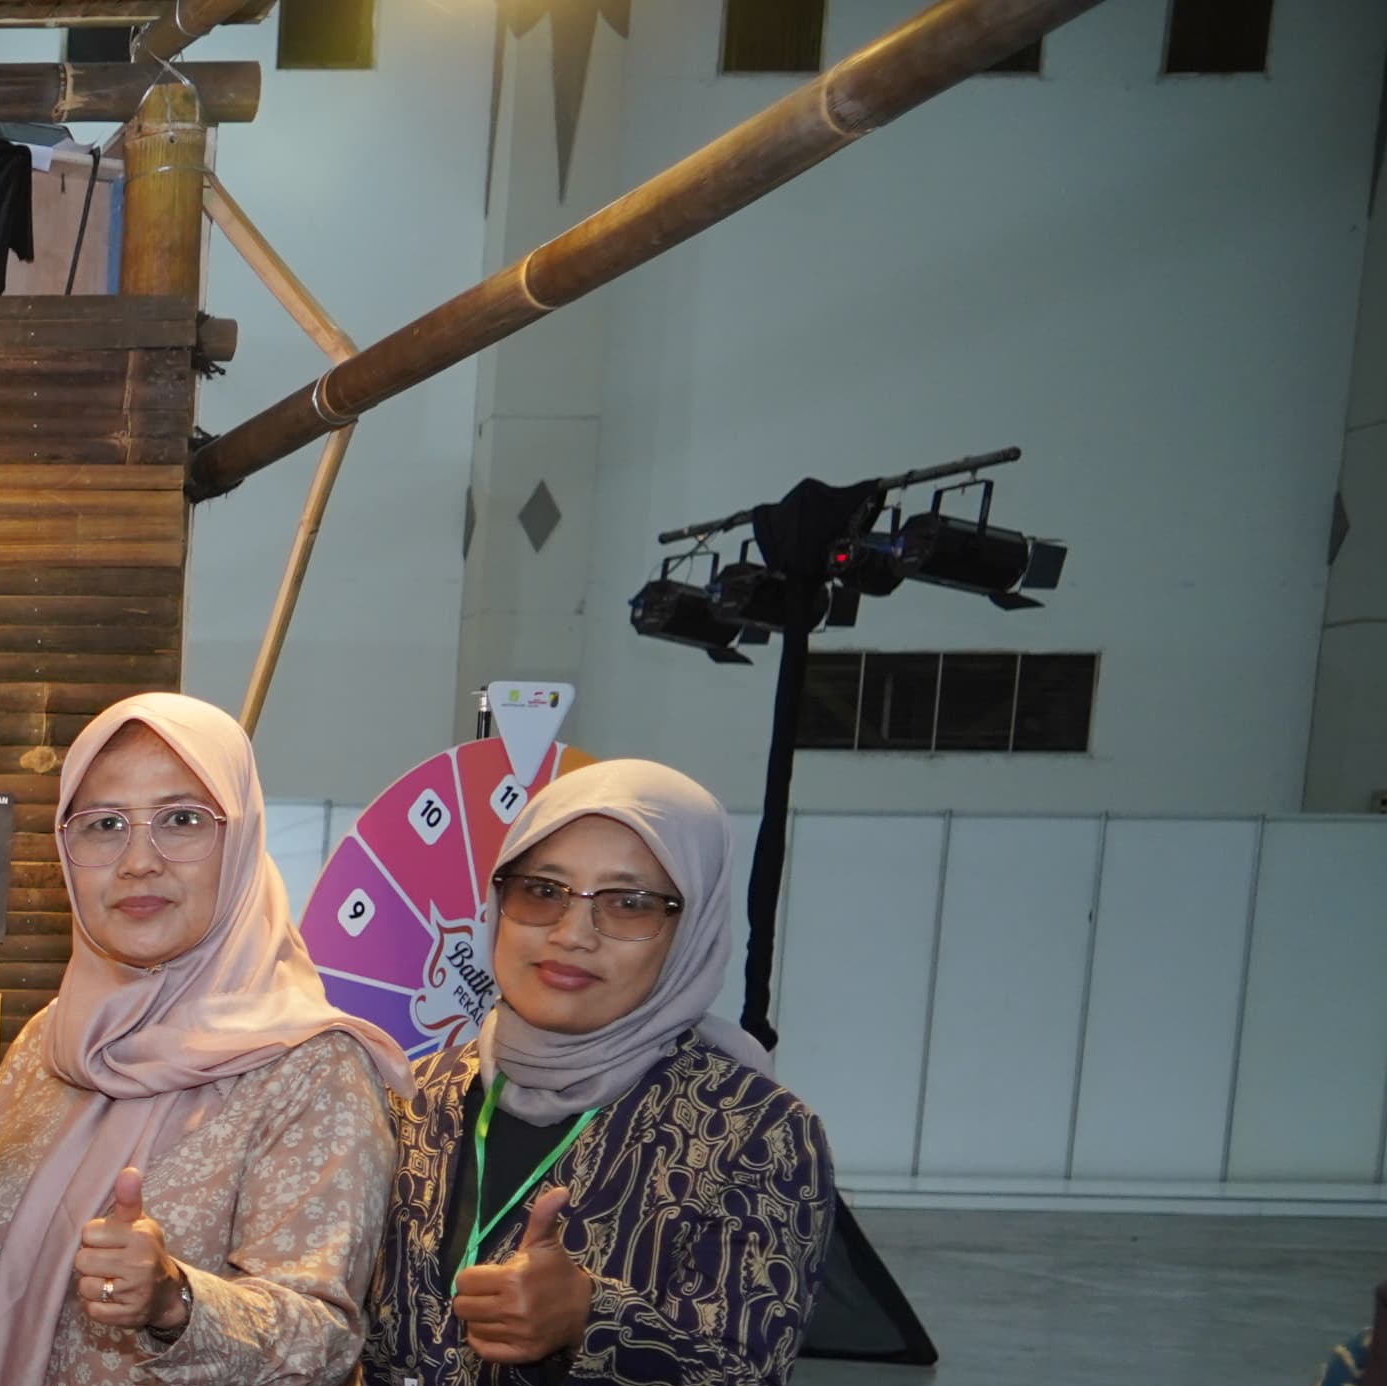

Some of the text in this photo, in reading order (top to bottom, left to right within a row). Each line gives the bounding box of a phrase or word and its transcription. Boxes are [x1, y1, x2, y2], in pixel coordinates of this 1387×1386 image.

[499, 785, 519, 810] 11
[420, 800, 442, 827] 10
[349, 901, 365, 919] 9
[446, 941, 495, 1009] Batik
[453, 985, 484, 1027] PEKAL
